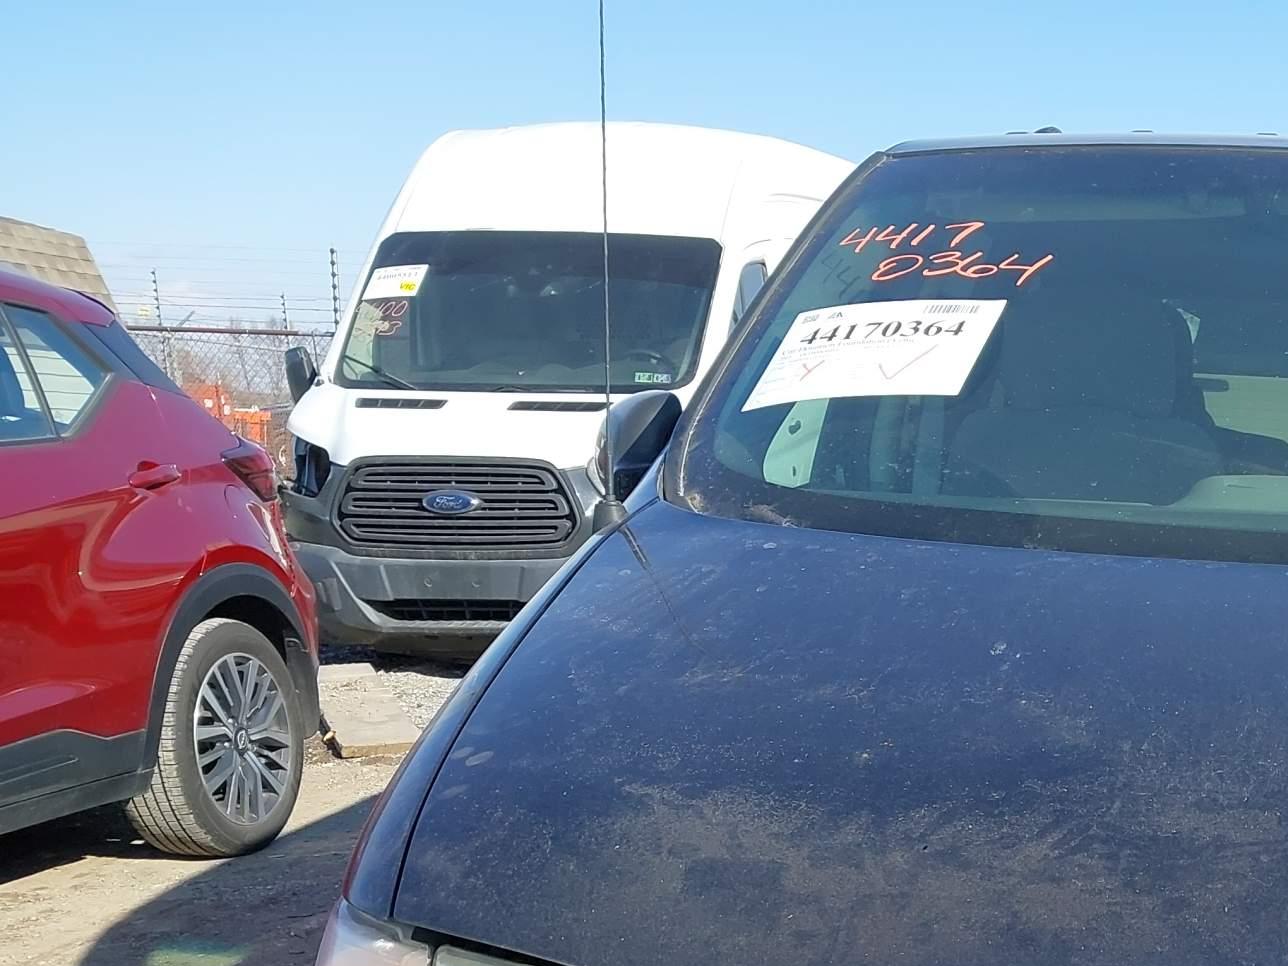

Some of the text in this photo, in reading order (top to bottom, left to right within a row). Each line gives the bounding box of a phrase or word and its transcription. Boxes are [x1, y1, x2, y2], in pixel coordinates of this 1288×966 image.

[839, 221, 985, 254] 4417
[871, 250, 1054, 287] 0364
[799, 319, 966, 346] 44170364
[433, 495, 464, 509] Ford
